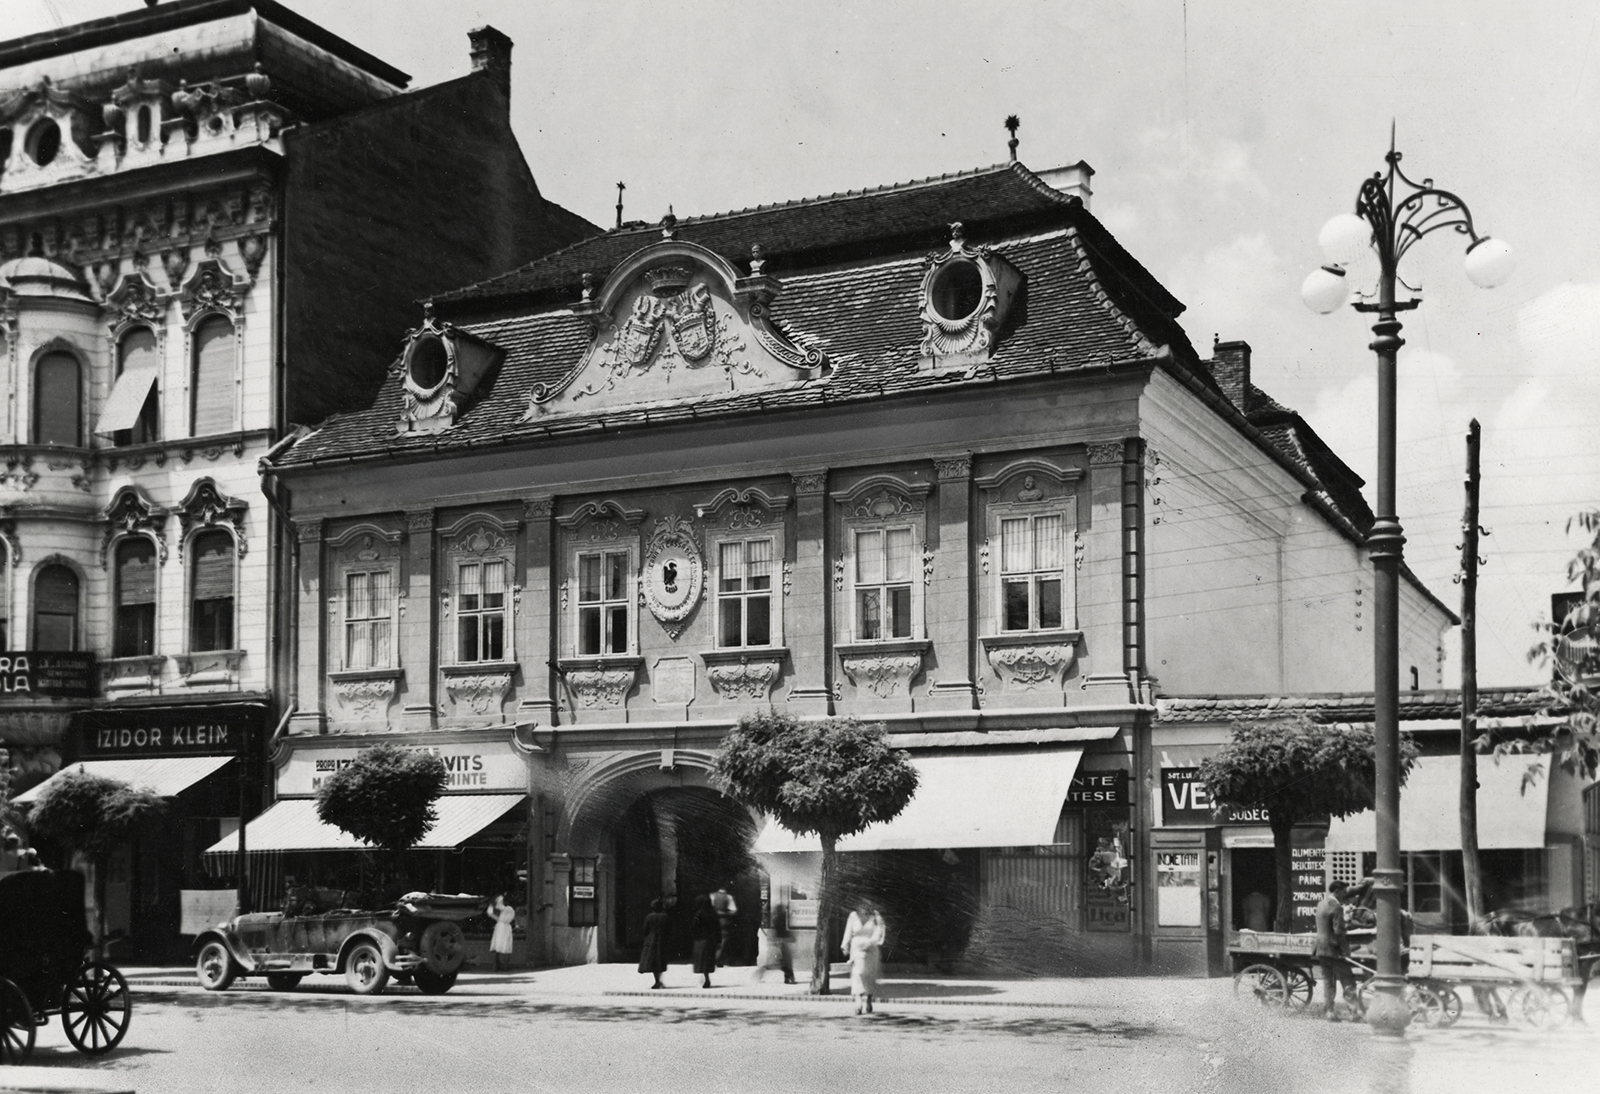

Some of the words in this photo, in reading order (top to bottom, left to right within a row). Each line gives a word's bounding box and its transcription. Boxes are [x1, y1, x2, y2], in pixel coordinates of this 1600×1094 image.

[0, 676, 31, 692] LA
[97, 728, 161, 748] IZIDOR
[173, 725, 228, 745] KLEIN
[439, 755, 483, 772] VITS
